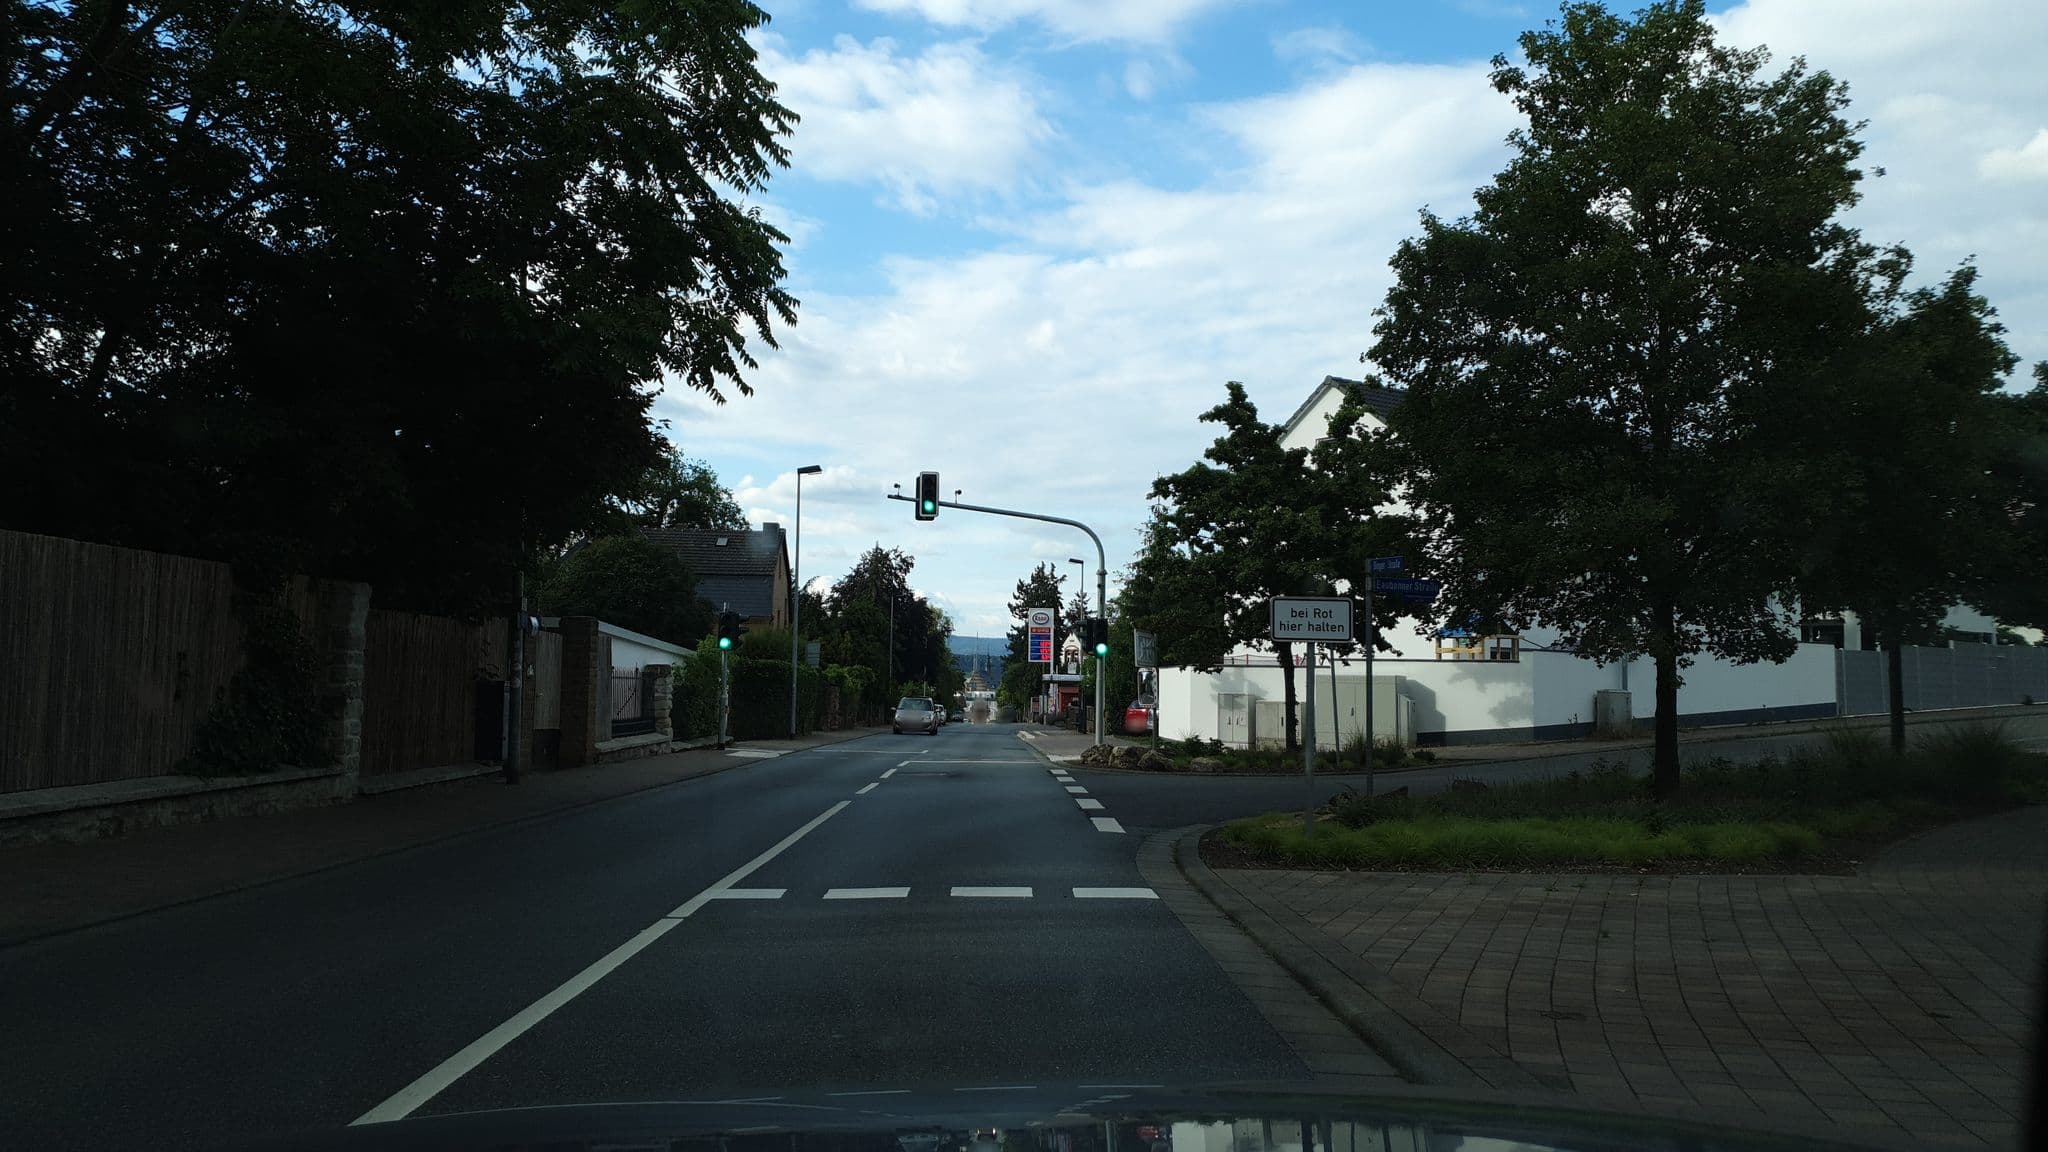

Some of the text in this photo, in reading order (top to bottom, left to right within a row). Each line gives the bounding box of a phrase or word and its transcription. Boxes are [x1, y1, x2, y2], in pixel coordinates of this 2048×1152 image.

[1290, 607, 1333, 619] bei Rot
[1279, 620, 1344, 632] hier halten
